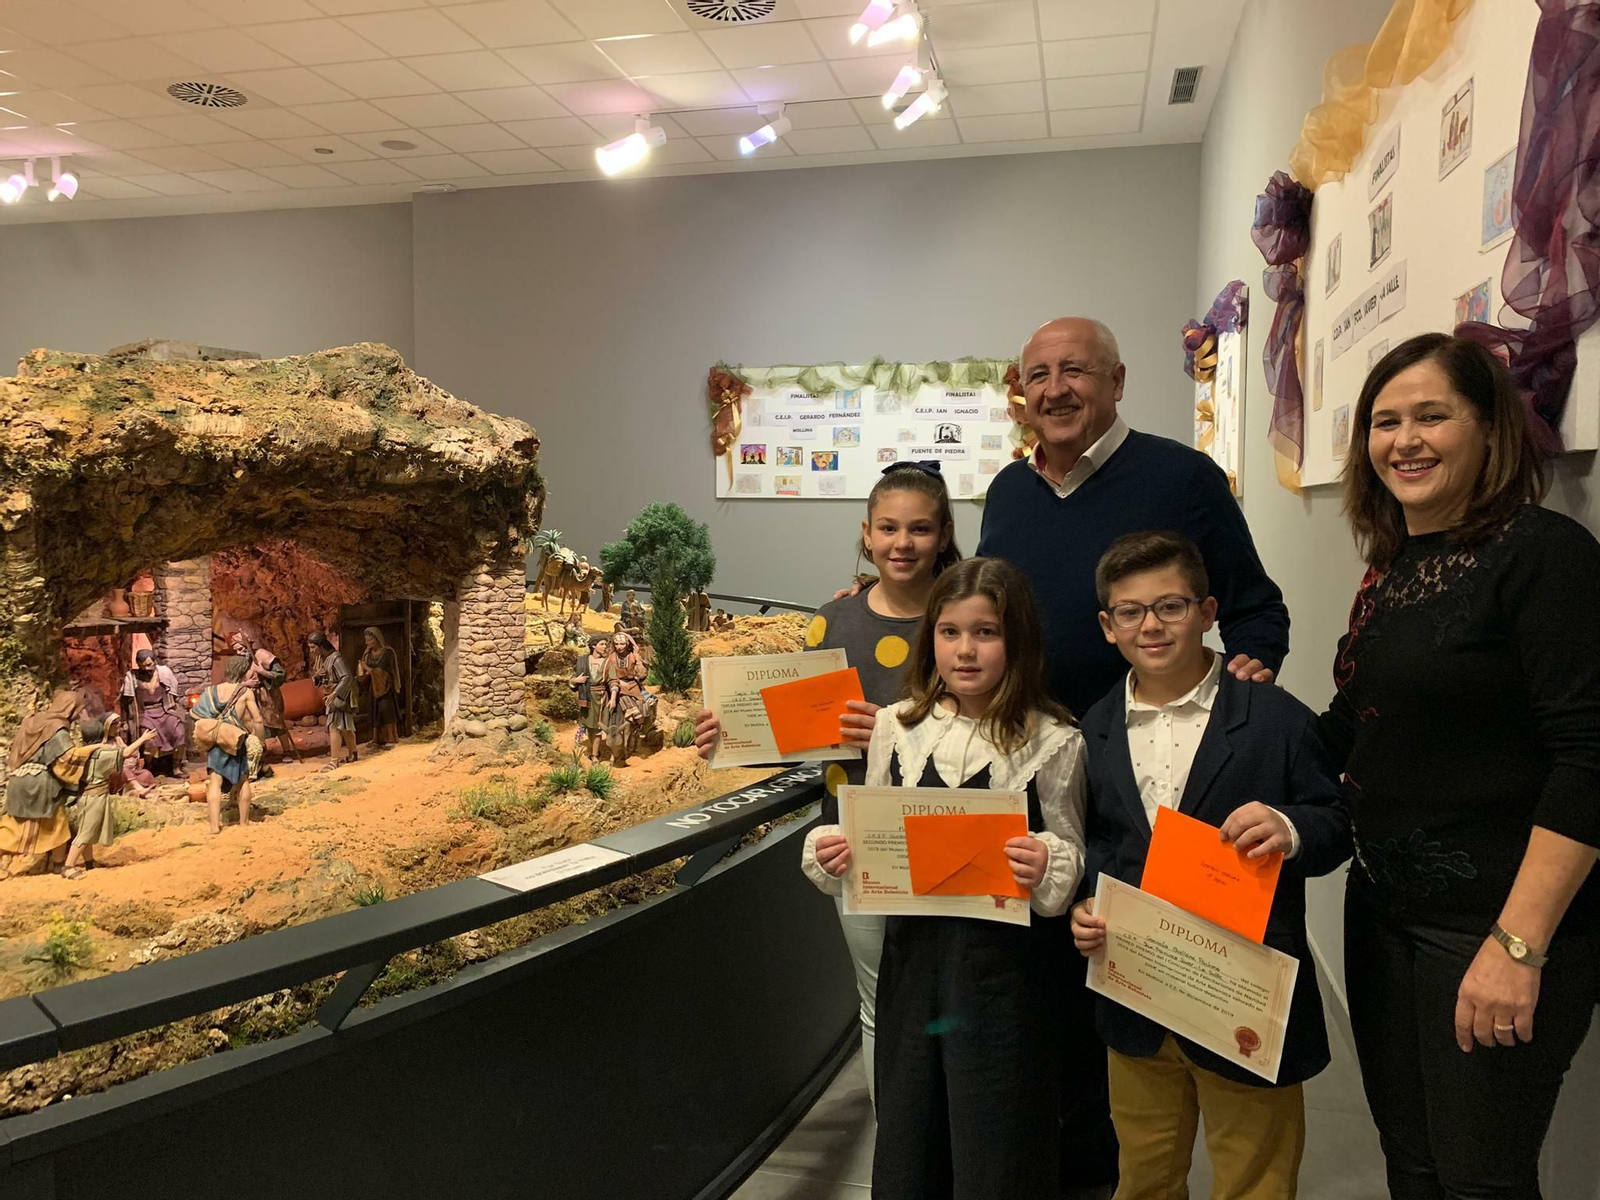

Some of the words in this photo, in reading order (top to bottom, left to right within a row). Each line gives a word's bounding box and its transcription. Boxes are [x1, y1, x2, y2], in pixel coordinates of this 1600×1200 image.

[1372, 145, 1396, 185] FINALISTAS
[1364, 294, 1377, 318] JAVIER
[1386, 274, 1400, 296] SALLE
[746, 668, 800, 680] DIPLOMA
[902, 804, 966, 815] DIPLOMA
[666, 812, 711, 828] NO
[1159, 918, 1228, 958] DIPLOMA
[1243, 992, 1266, 1007] Navidad
